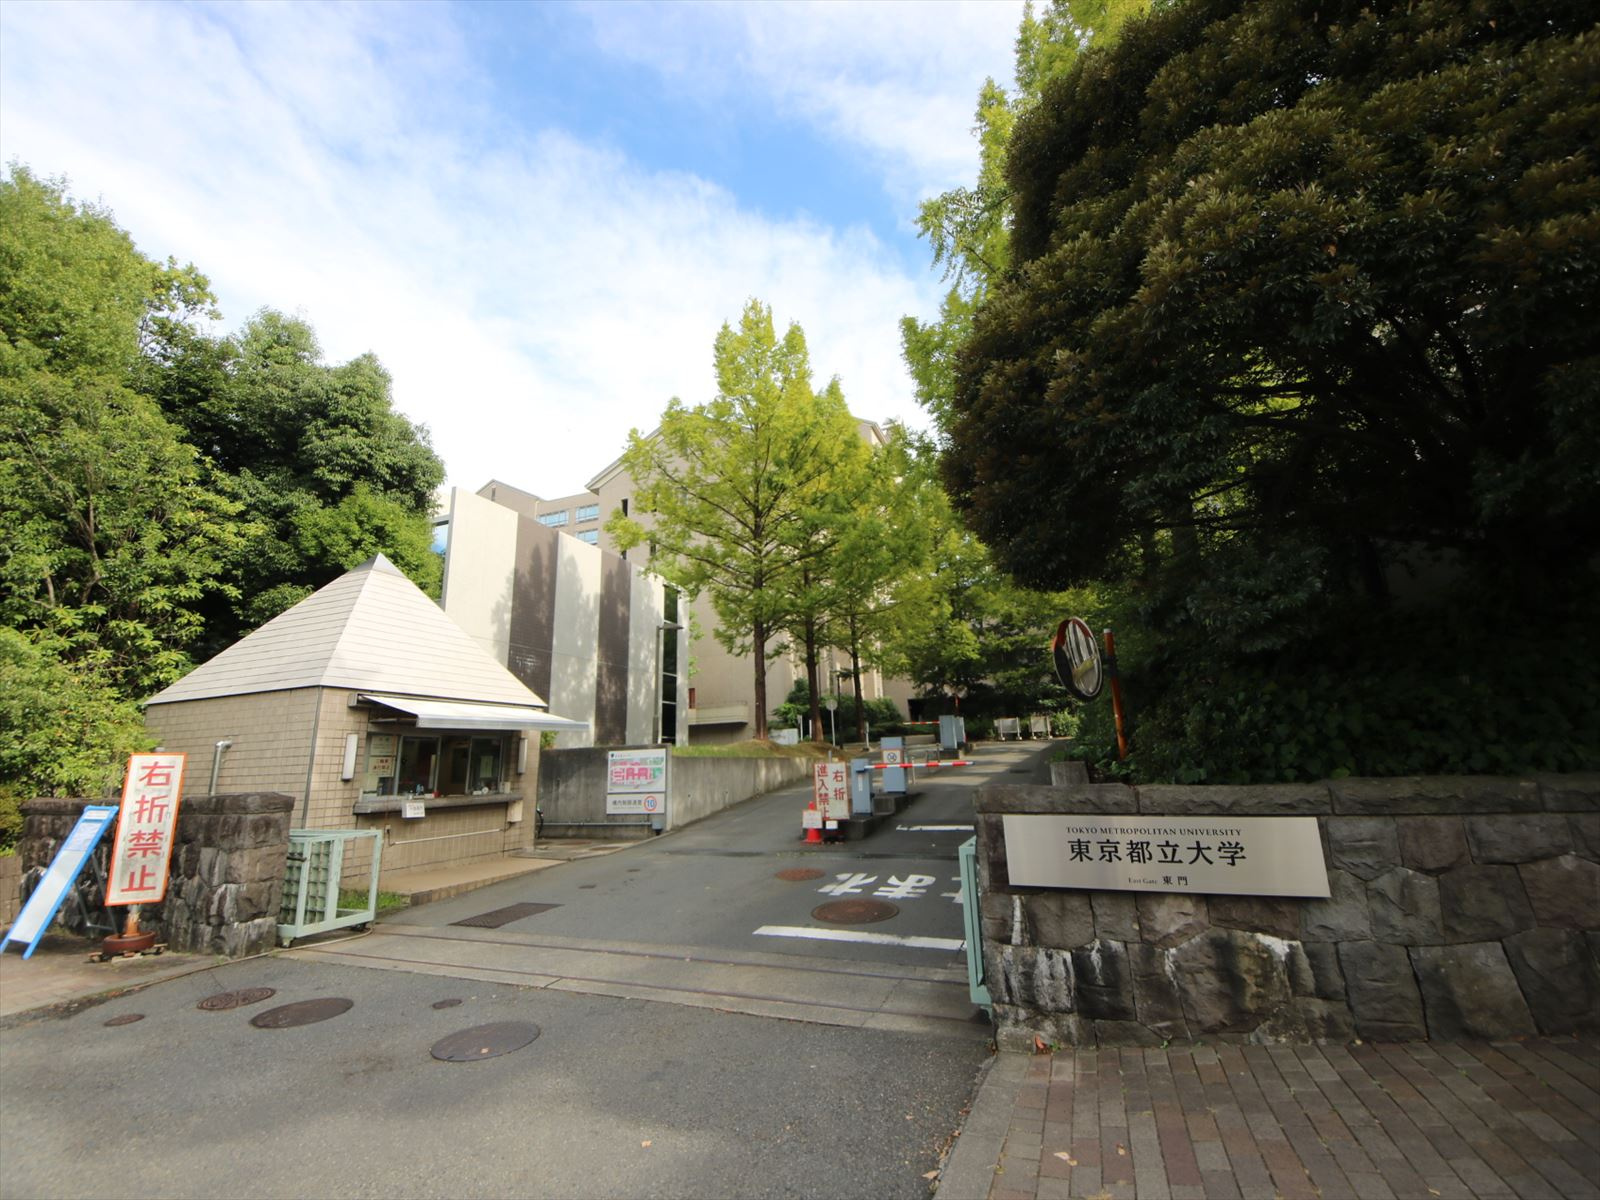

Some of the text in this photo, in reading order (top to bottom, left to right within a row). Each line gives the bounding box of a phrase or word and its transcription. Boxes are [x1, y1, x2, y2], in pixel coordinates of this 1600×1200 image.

[832, 769, 846, 801] 右折
[121, 761, 175, 892] 右折禁止
[1066, 826, 1242, 837] TOKYO METROPOLITAN UNIVERSITY
[1067, 838, 1246, 867] 東京都立大学
[1162, 875, 1188, 886] 東門
